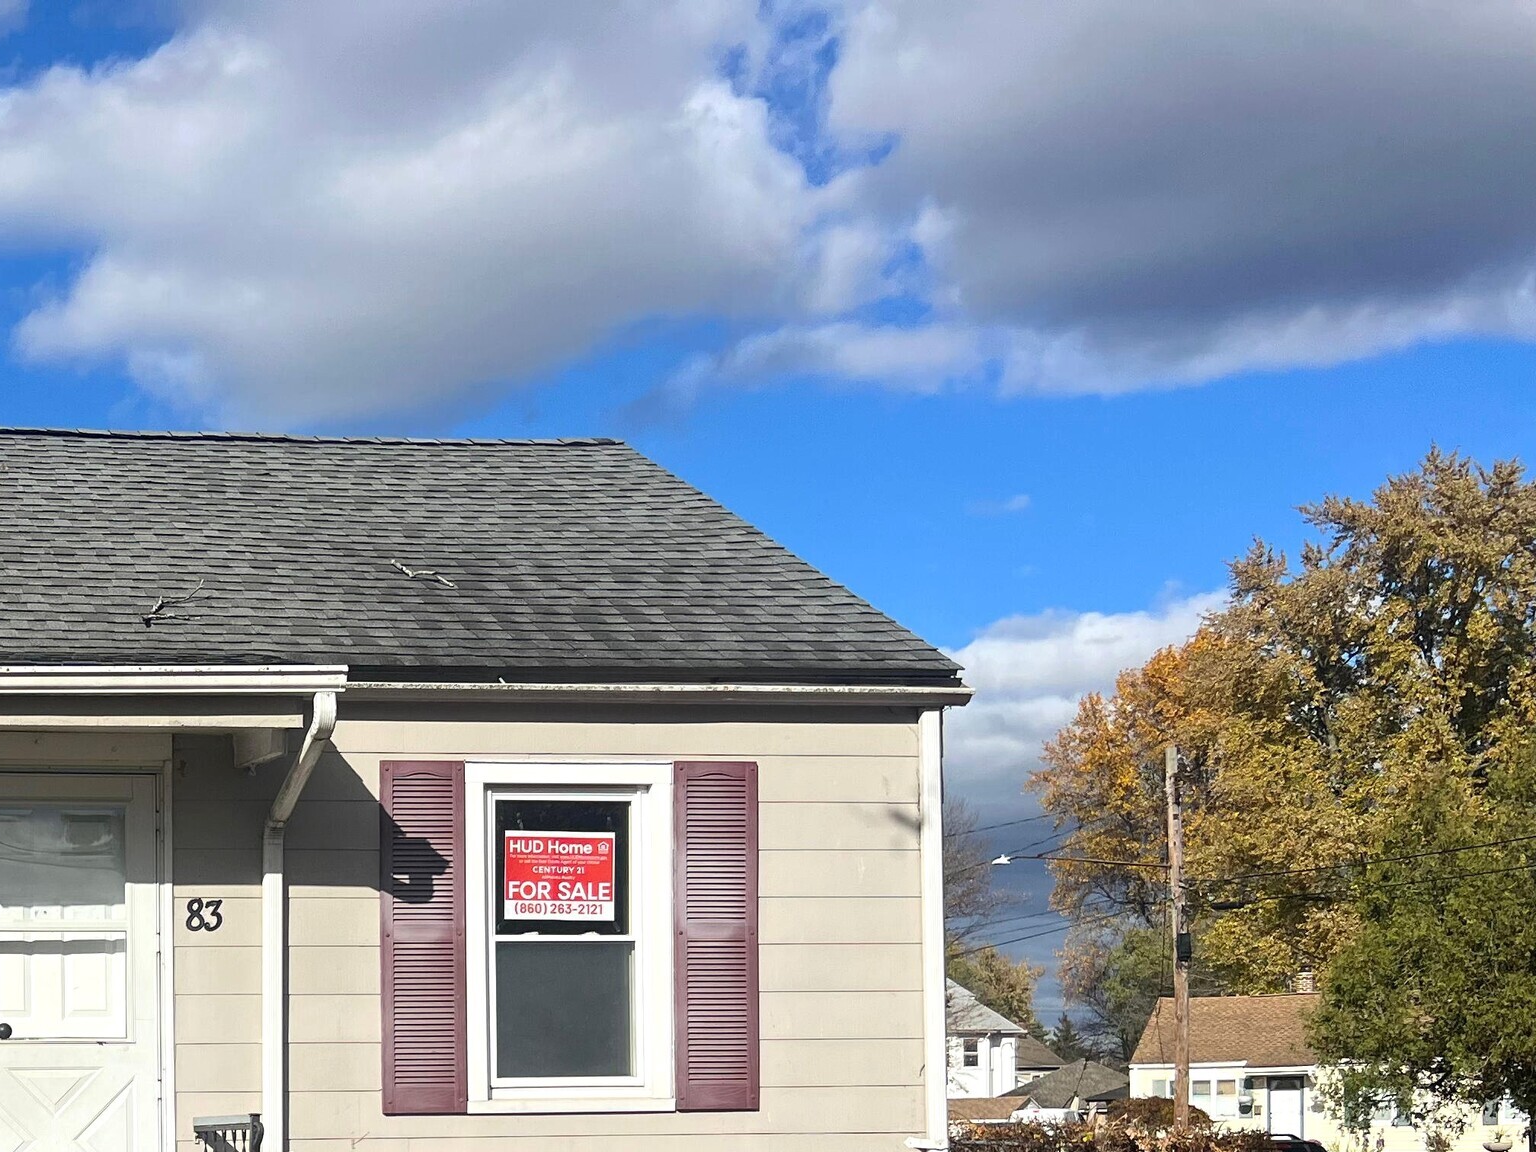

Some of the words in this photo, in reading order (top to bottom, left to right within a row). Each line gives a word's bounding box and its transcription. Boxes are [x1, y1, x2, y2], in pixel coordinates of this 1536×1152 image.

[509, 839, 544, 854] HUD
[547, 840, 593, 855] Home
[532, 865, 575, 875] CENTURY
[576, 866, 585, 875] 21
[508, 880, 552, 900] FOR
[557, 881, 611, 901] SALE
[185, 897, 223, 932] 83
[514, 901, 548, 915] (860)
[550, 902, 603, 915] 263-2121
